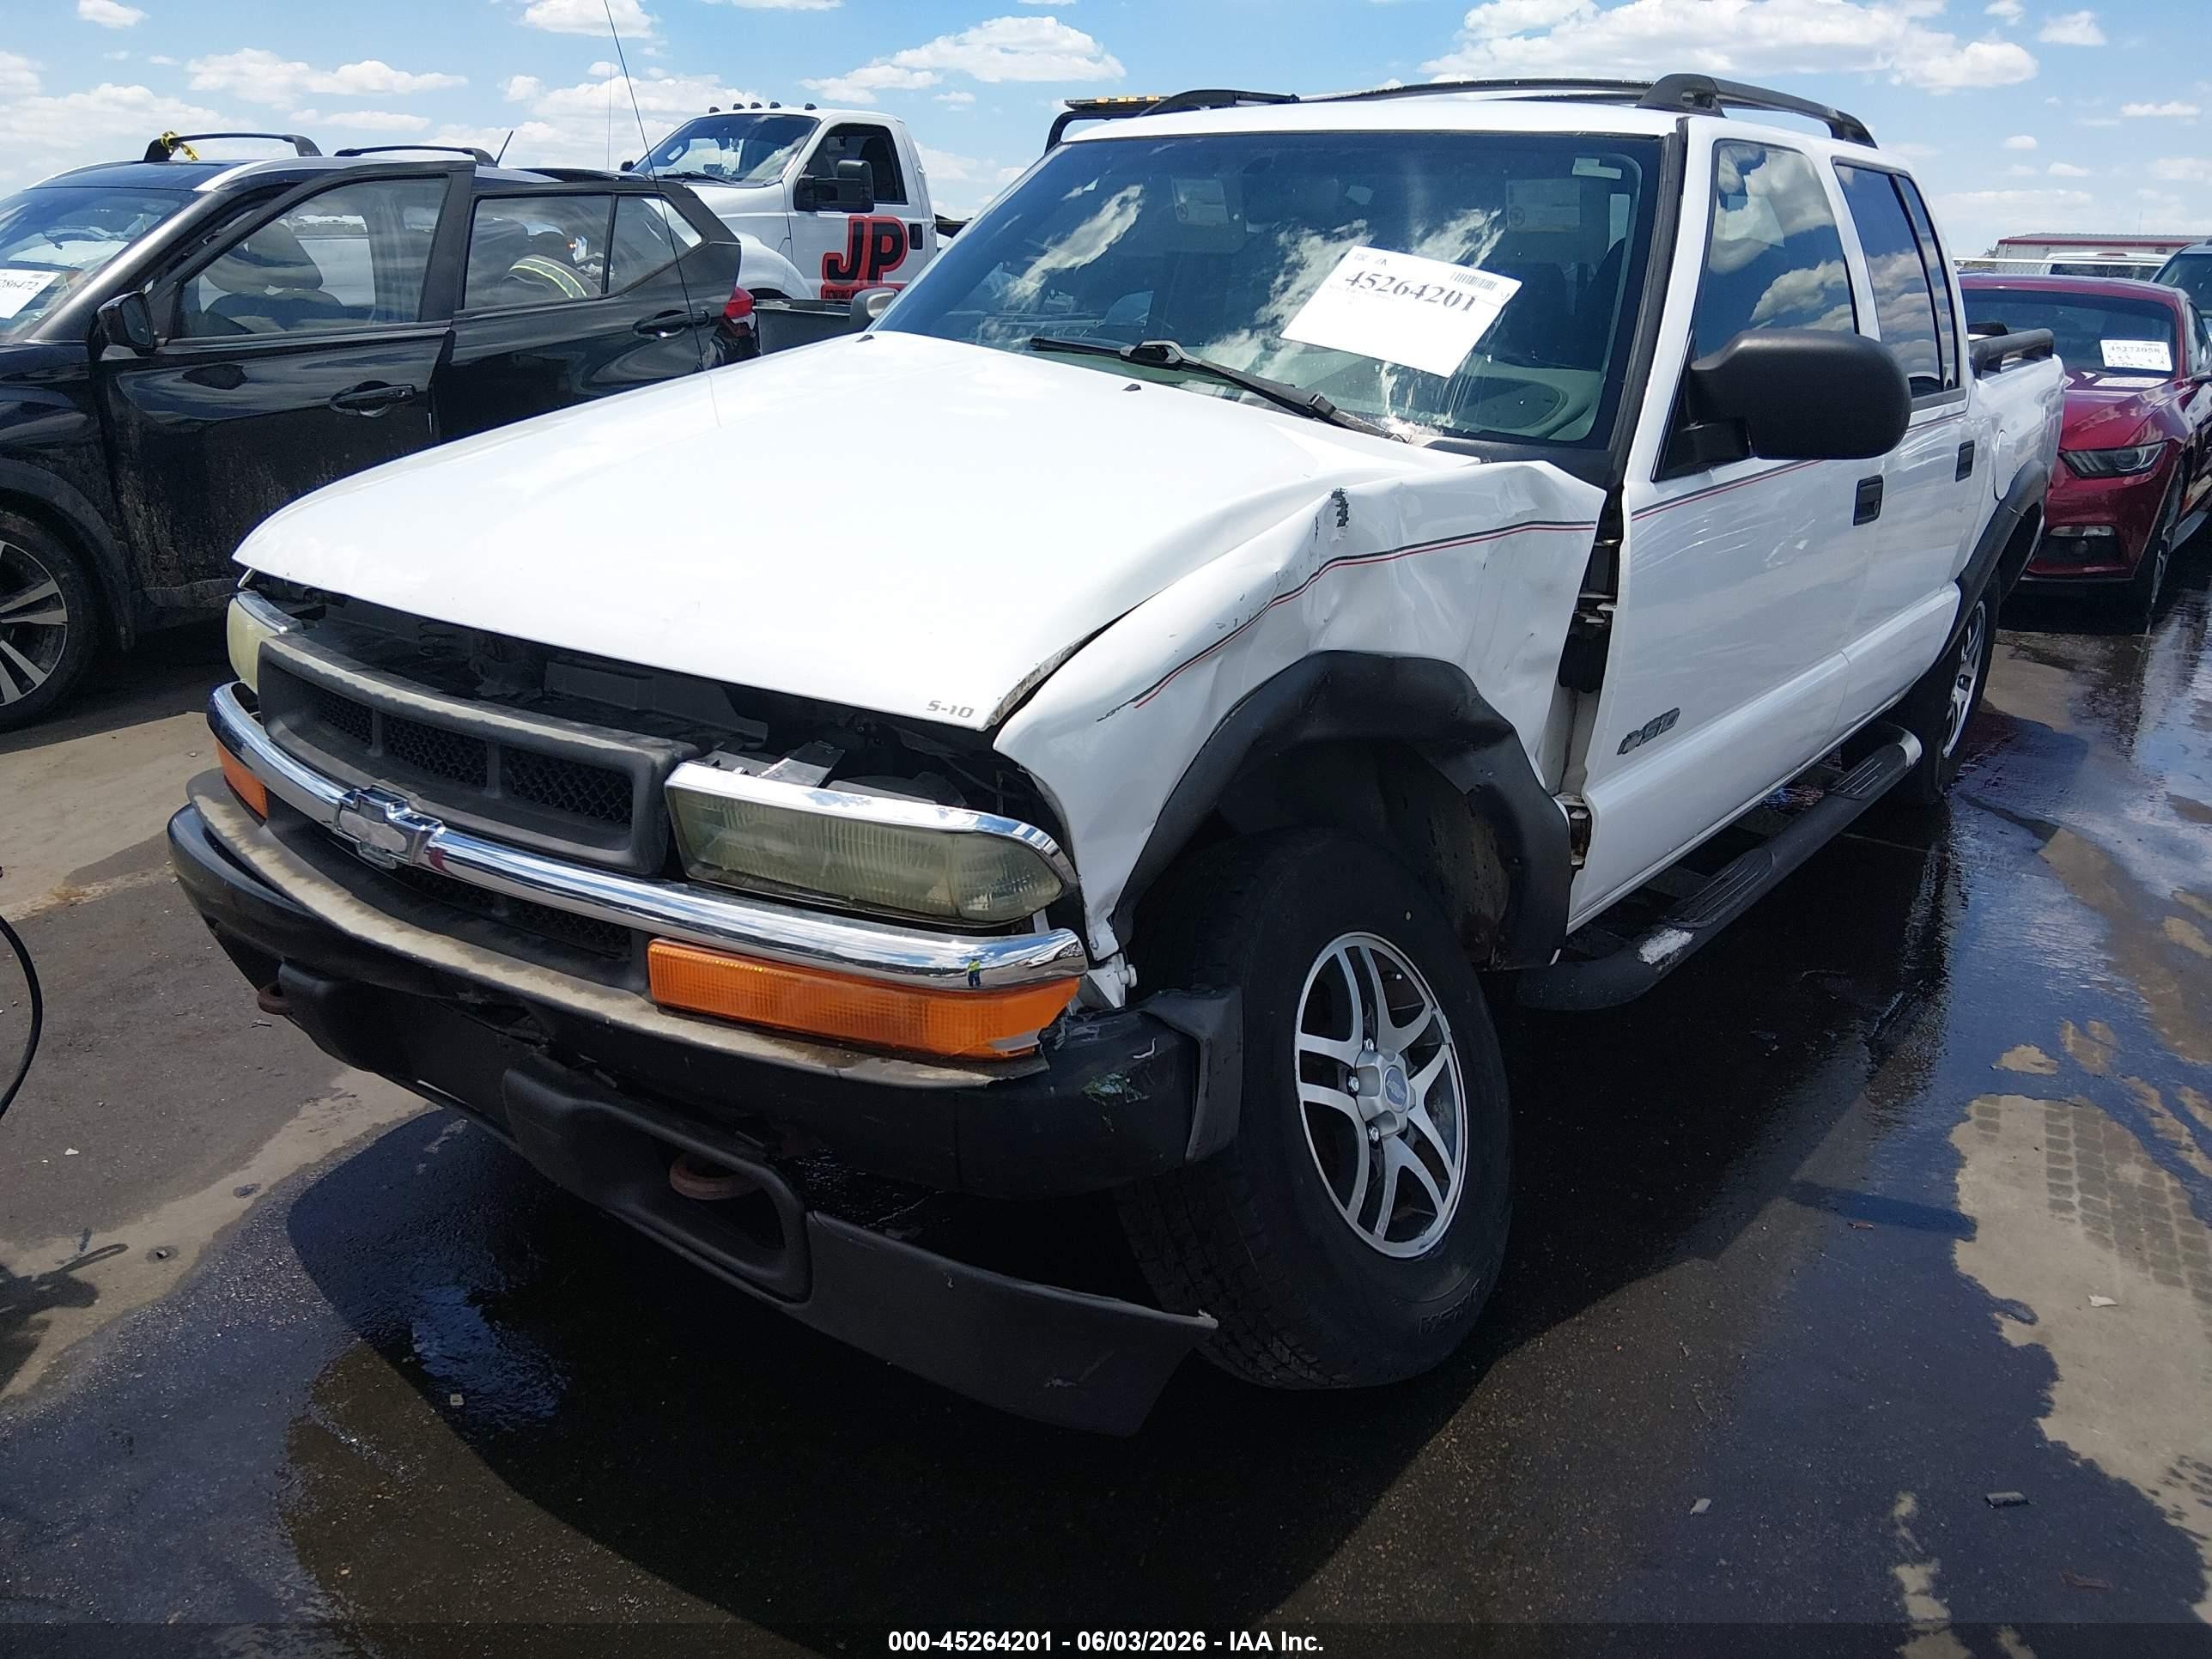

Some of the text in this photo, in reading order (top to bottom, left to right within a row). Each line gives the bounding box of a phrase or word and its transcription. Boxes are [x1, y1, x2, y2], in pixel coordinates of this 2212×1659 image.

[823, 216, 907, 285] JP
[1345, 270, 1476, 312] 45264201
[926, 700, 975, 718] S-10
